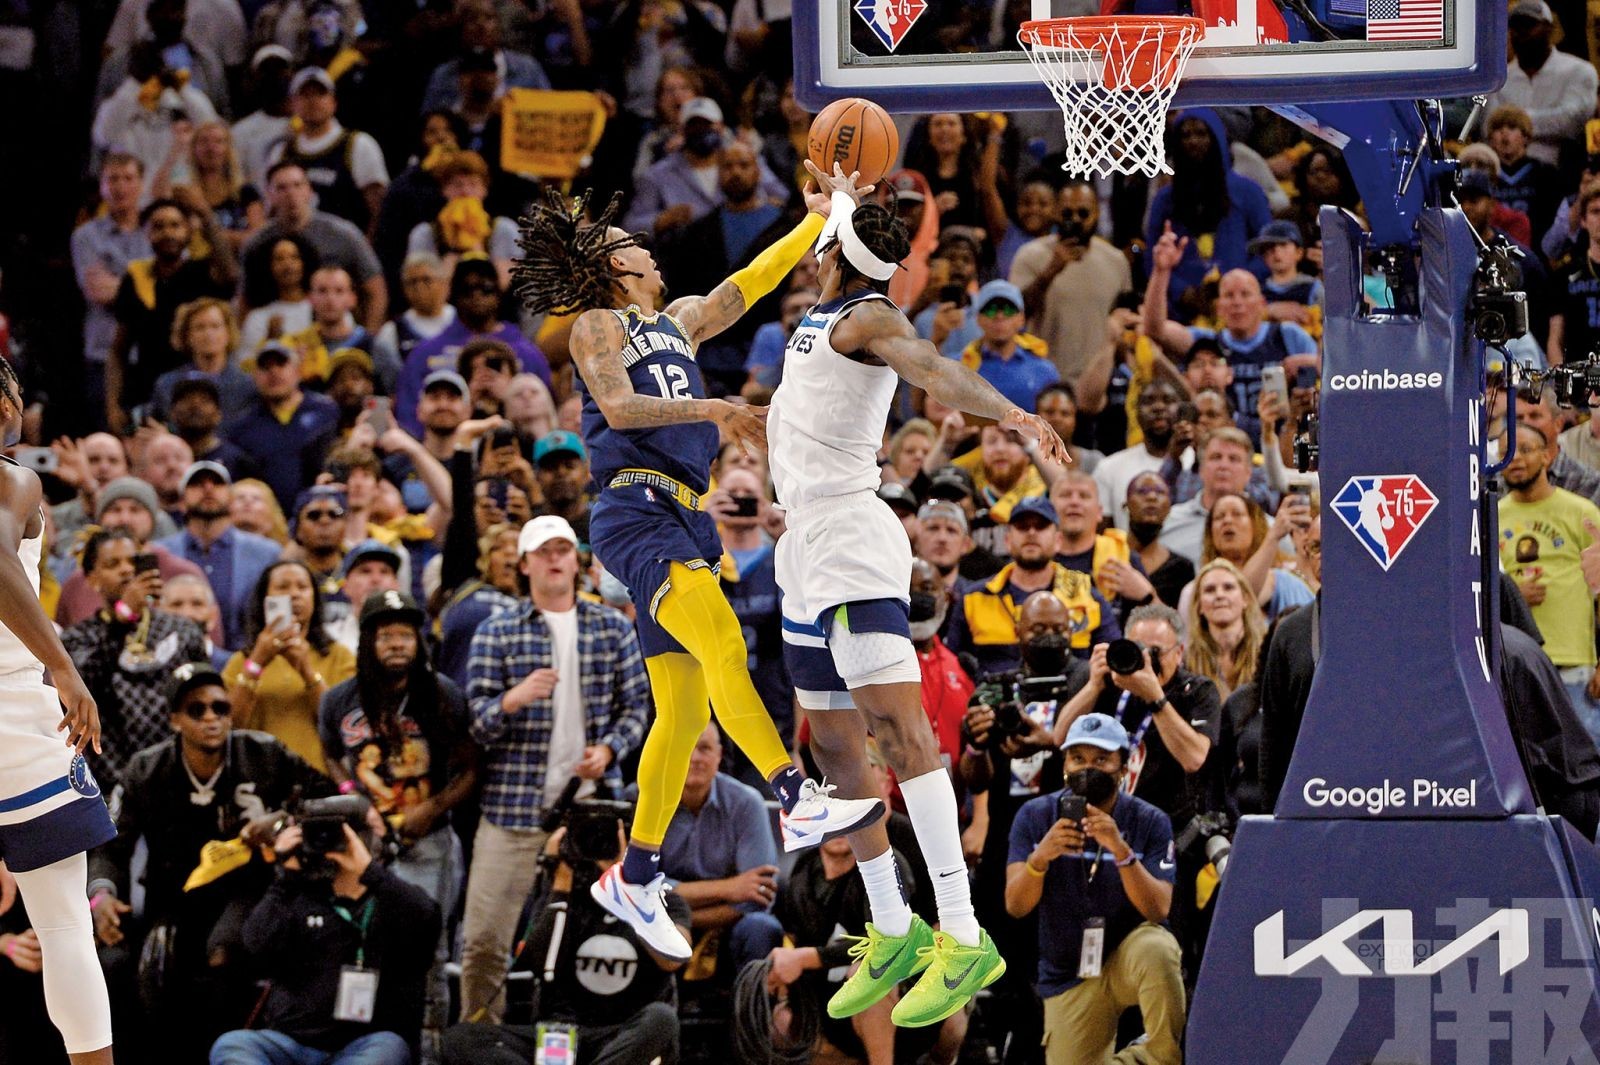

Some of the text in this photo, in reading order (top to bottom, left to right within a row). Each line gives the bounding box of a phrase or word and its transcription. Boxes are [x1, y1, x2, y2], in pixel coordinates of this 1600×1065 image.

[647, 363, 693, 400] 12
[1330, 368, 1443, 391] coinbase
[1393, 488, 1414, 517] 75
[1303, 777, 1476, 815] Google Pixel
[1253, 908, 1529, 976] KIA
[576, 956, 638, 978] TNT
